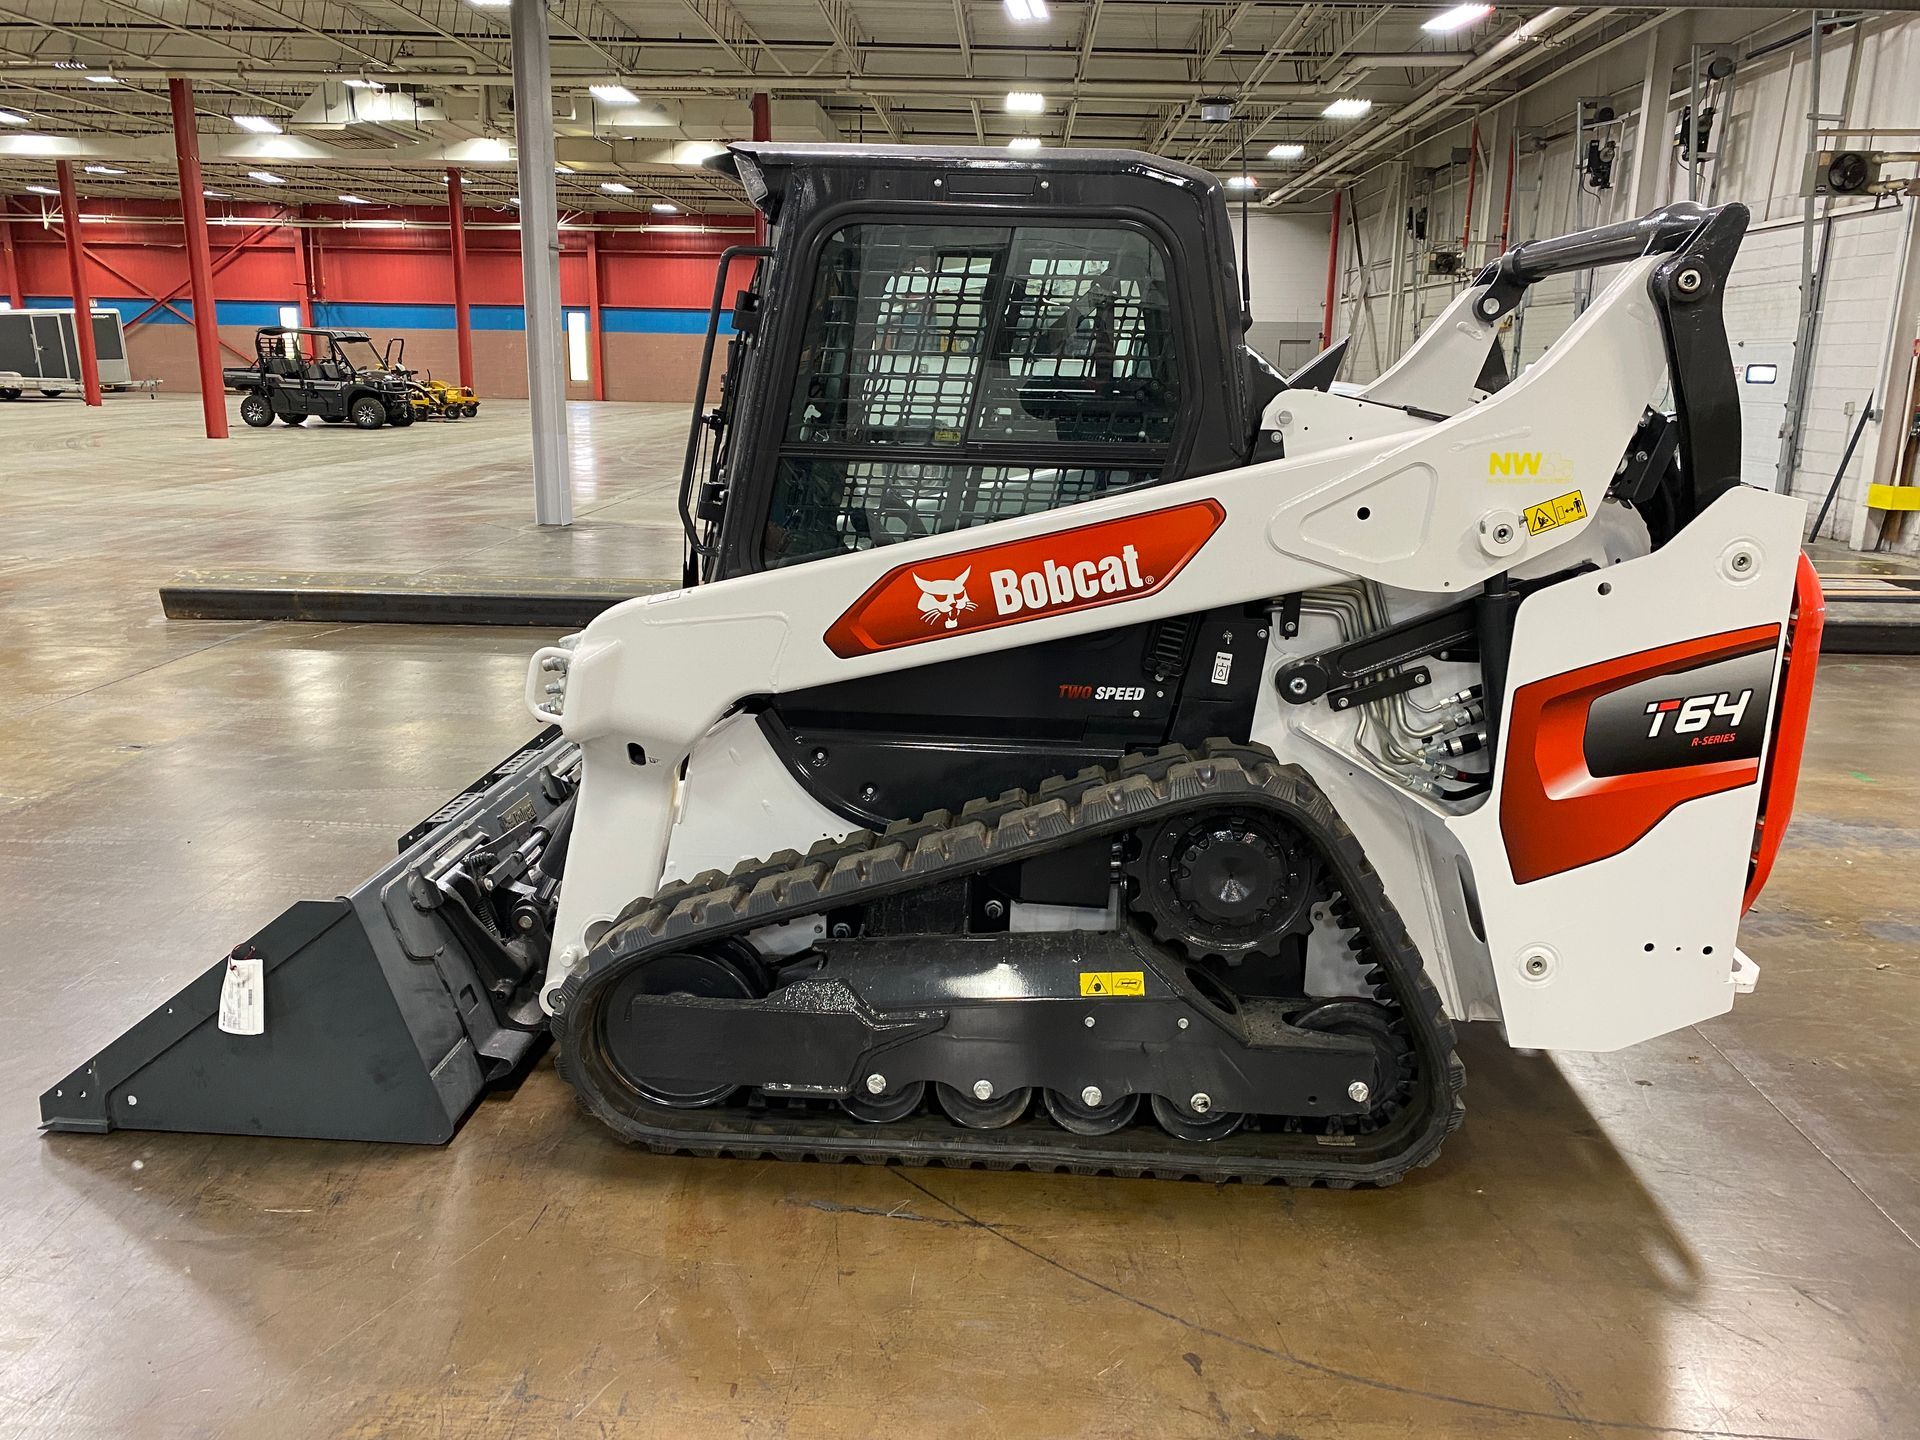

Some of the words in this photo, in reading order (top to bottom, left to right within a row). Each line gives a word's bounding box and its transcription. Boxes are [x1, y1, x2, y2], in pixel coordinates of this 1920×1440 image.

[1489, 452, 1542, 475] NW
[990, 544, 1144, 616] Bobcat
[1059, 684, 1093, 699] TWO
[1095, 686, 1146, 700] SPEED
[1646, 690, 1752, 738] T64
[1691, 733, 1736, 747] R-SERIES
